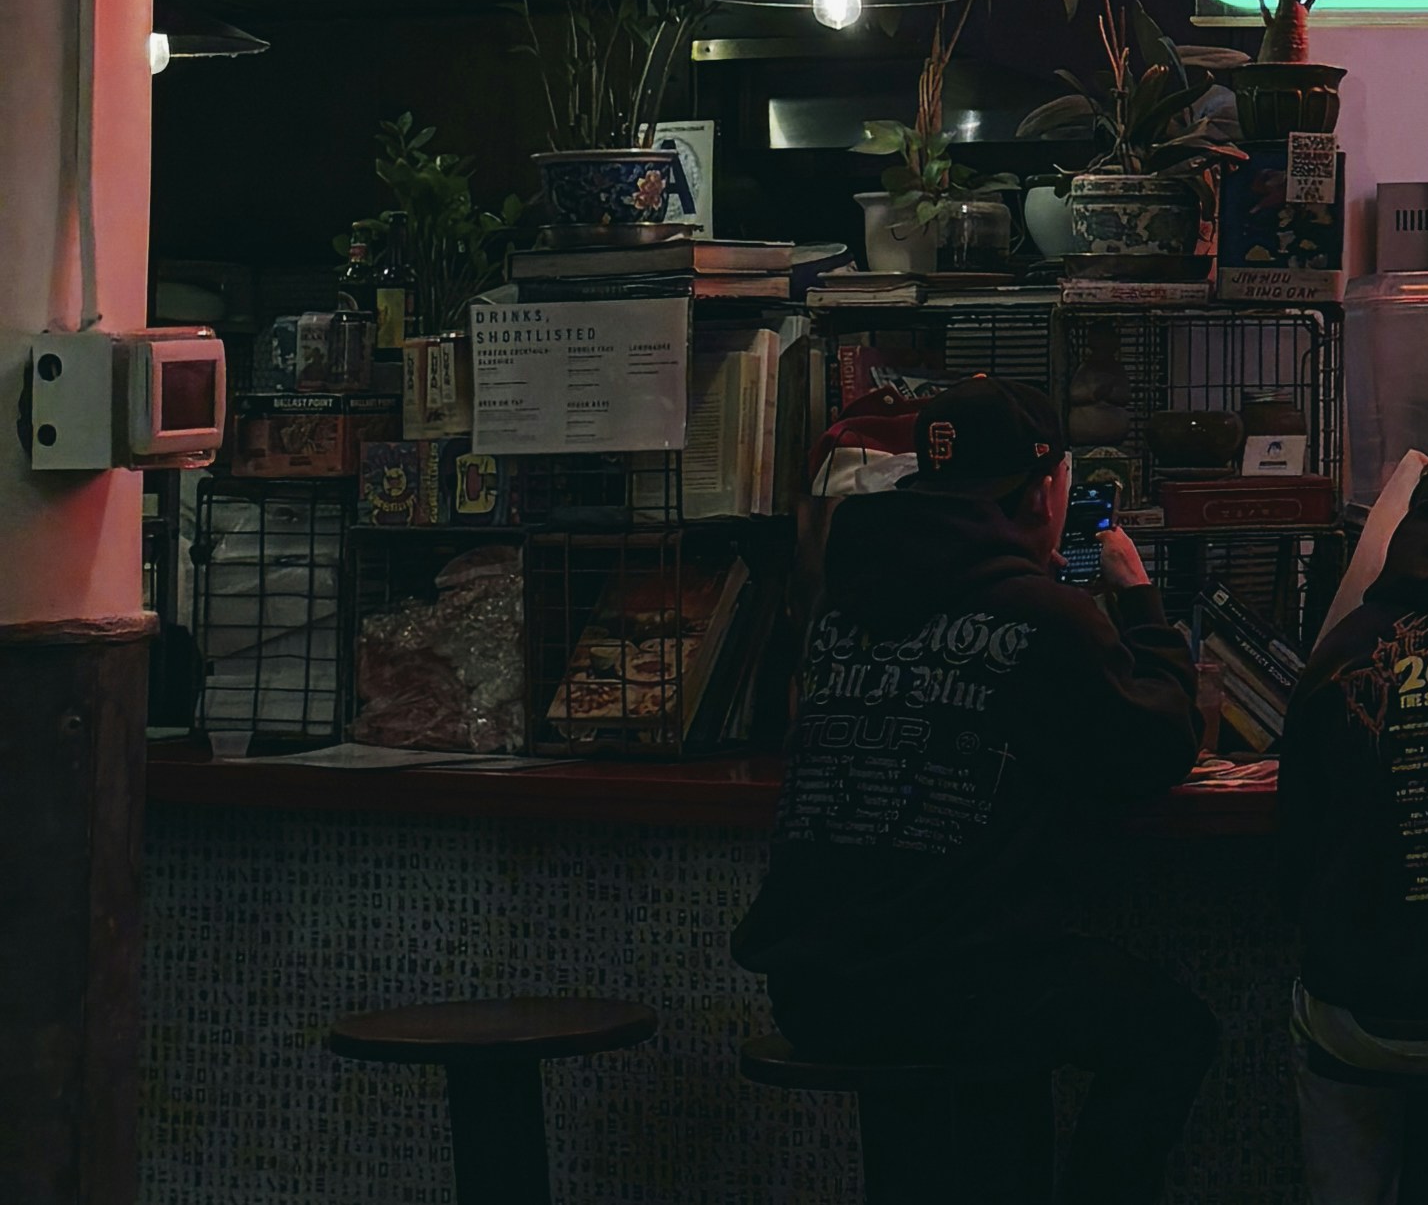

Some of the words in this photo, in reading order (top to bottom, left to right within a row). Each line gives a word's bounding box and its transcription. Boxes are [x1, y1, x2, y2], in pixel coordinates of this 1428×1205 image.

[475, 309, 551, 325] DRINKS,
[476, 327, 596, 344] SHORTLISTED
[1400, 693, 1423, 709] THE
